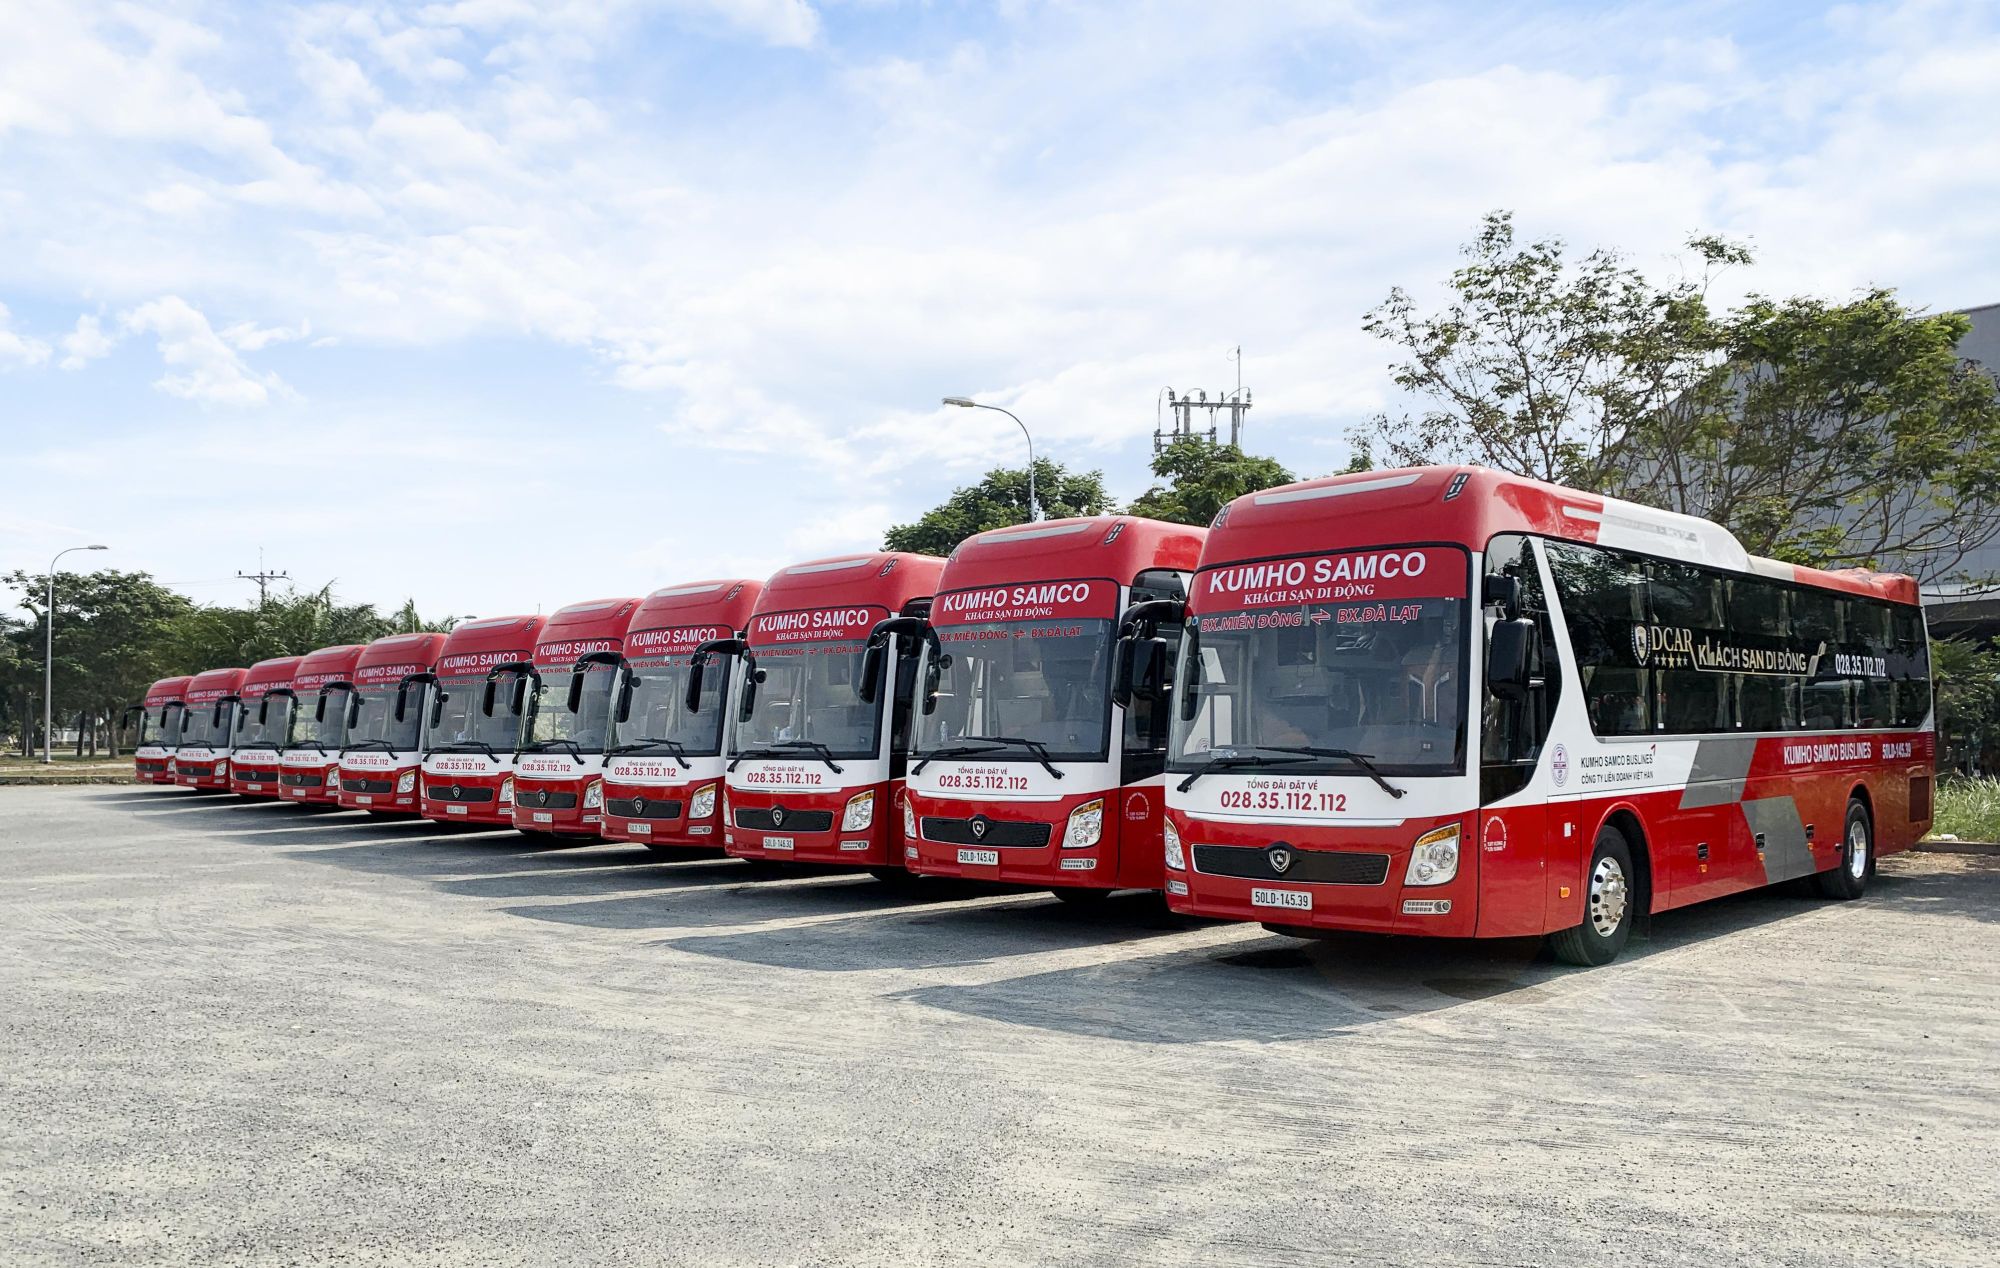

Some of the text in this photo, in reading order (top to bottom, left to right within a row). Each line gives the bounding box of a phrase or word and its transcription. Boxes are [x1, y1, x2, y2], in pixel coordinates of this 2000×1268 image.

[1209, 551, 1426, 593] KUMHO SAMCO
[943, 583, 1090, 612] KUMHO SAMCO
[1244, 583, 1375, 605] KHÁCH SẠN DI ĐỘNG
[758, 609, 869, 633] KUMHO SAMCO
[964, 605, 1052, 621] KHÁCH SẠN DI ĐỘNG
[1257, 610, 1302, 628] ĐÔNG
[1337, 603, 1387, 624] BX.ĐÀ
[1389, 604, 1422, 624] LẠT
[631, 628, 717, 647] KUMHO SAMCO
[776, 628, 843, 641] KHÁCH SẠN DI ĐỘNG
[1651, 626, 1692, 653] DCAR
[540, 641, 610, 657] KUMHO SAMCO
[443, 653, 518, 669] KUMHO SAMCO
[1742, 649, 1765, 673] SẠN
[1766, 651, 1777, 670] DI
[1778, 648, 1806, 675] ĐỘNG
[1835, 653, 1886, 677] 028.35.112.112
[297, 674, 344, 684] KUMHO SAMCO
[358, 665, 416, 678] KUMHO SAMCO
[245, 682, 269, 692] KUMHO
[1783, 742, 1871, 765] KUMHO SAMCO BUSLINES
[1882, 742, 1911, 760] 50LD-145.39
[436, 762, 486, 770] 028.35.112.112
[522, 763, 571, 772] 028.35.112.112
[1581, 753, 1653, 768] KUMHO SAMCO BUSLINES
[614, 767, 677, 777] 028.35.112.112
[747, 772, 821, 785] 028.35.112.112
[1581, 772, 1596, 784] CÔNG
[1597, 774, 1603, 783] TY
[1604, 772, 1616, 782] LIÊN
[1616, 772, 1632, 781] DOANH
[939, 775, 1028, 790] 028.35.112.112
[1247, 777, 1269, 789] TỔNG
[1272, 779, 1286, 789] ĐÀI
[1289, 780, 1305, 792] ĐẶT
[1220, 791, 1346, 812] 028.35.112.112
[1255, 891, 1308, 907] 50LD-145.39
